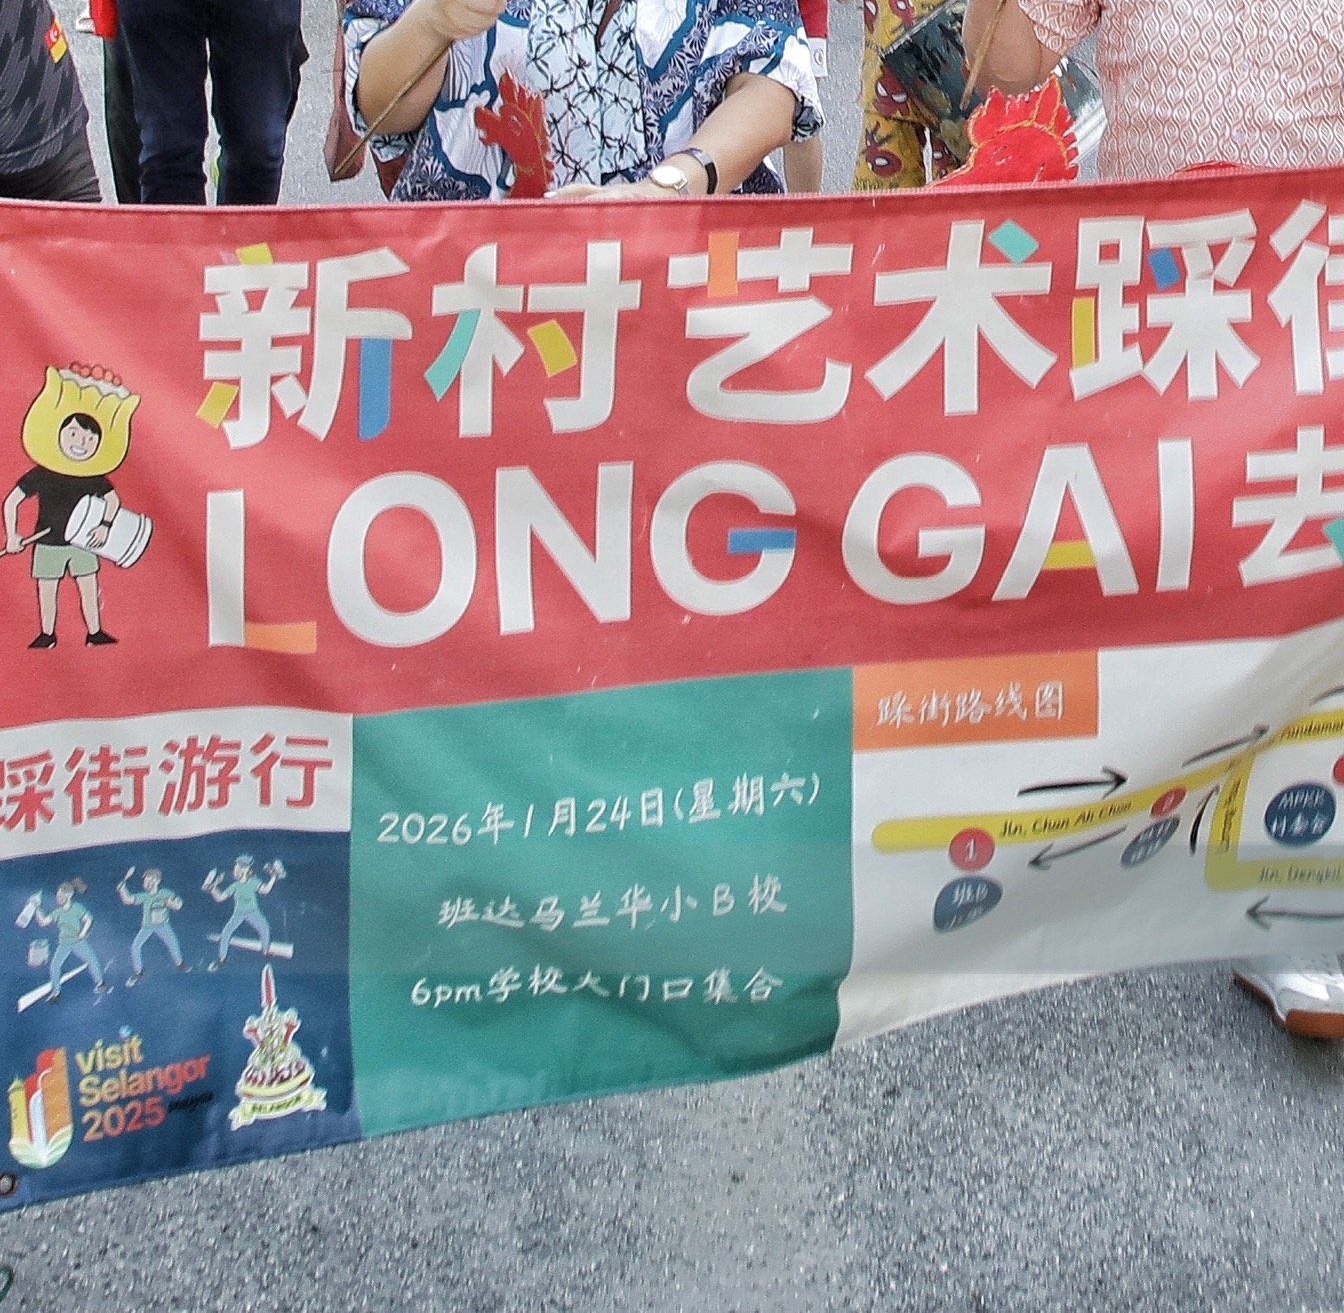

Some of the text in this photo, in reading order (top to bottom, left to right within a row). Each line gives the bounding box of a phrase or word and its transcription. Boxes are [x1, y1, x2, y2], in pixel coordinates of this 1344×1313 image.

[207, 461, 797, 655] LONG
[843, 439, 1193, 604] GAI
[76, 1025, 143, 1075] visit
[79, 1055, 211, 1108] Selangor
[81, 1098, 167, 1143] 2025
